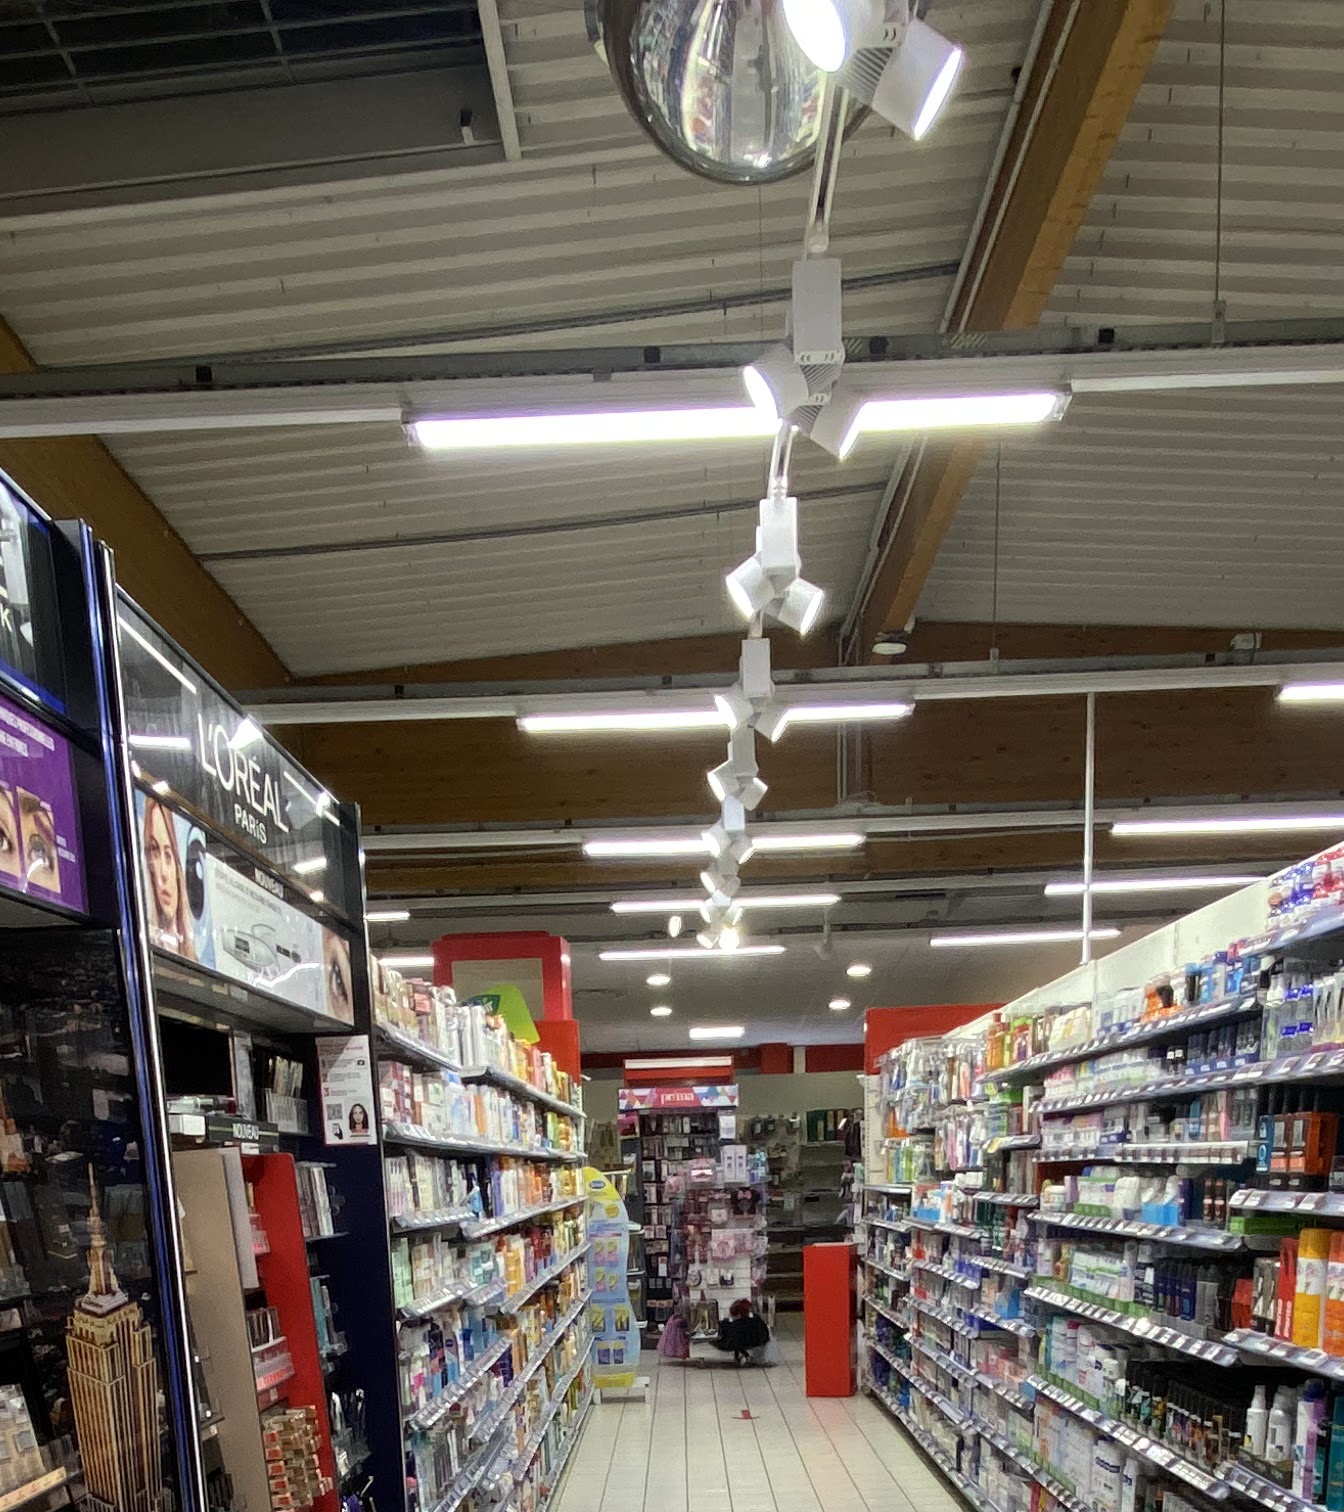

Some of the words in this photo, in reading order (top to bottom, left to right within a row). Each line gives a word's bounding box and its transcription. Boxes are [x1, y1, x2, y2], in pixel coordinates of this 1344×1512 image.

[196, 713, 290, 834] L'ORÉAL
[233, 802, 268, 846] PARIS
[660, 1092, 695, 1106] prima
